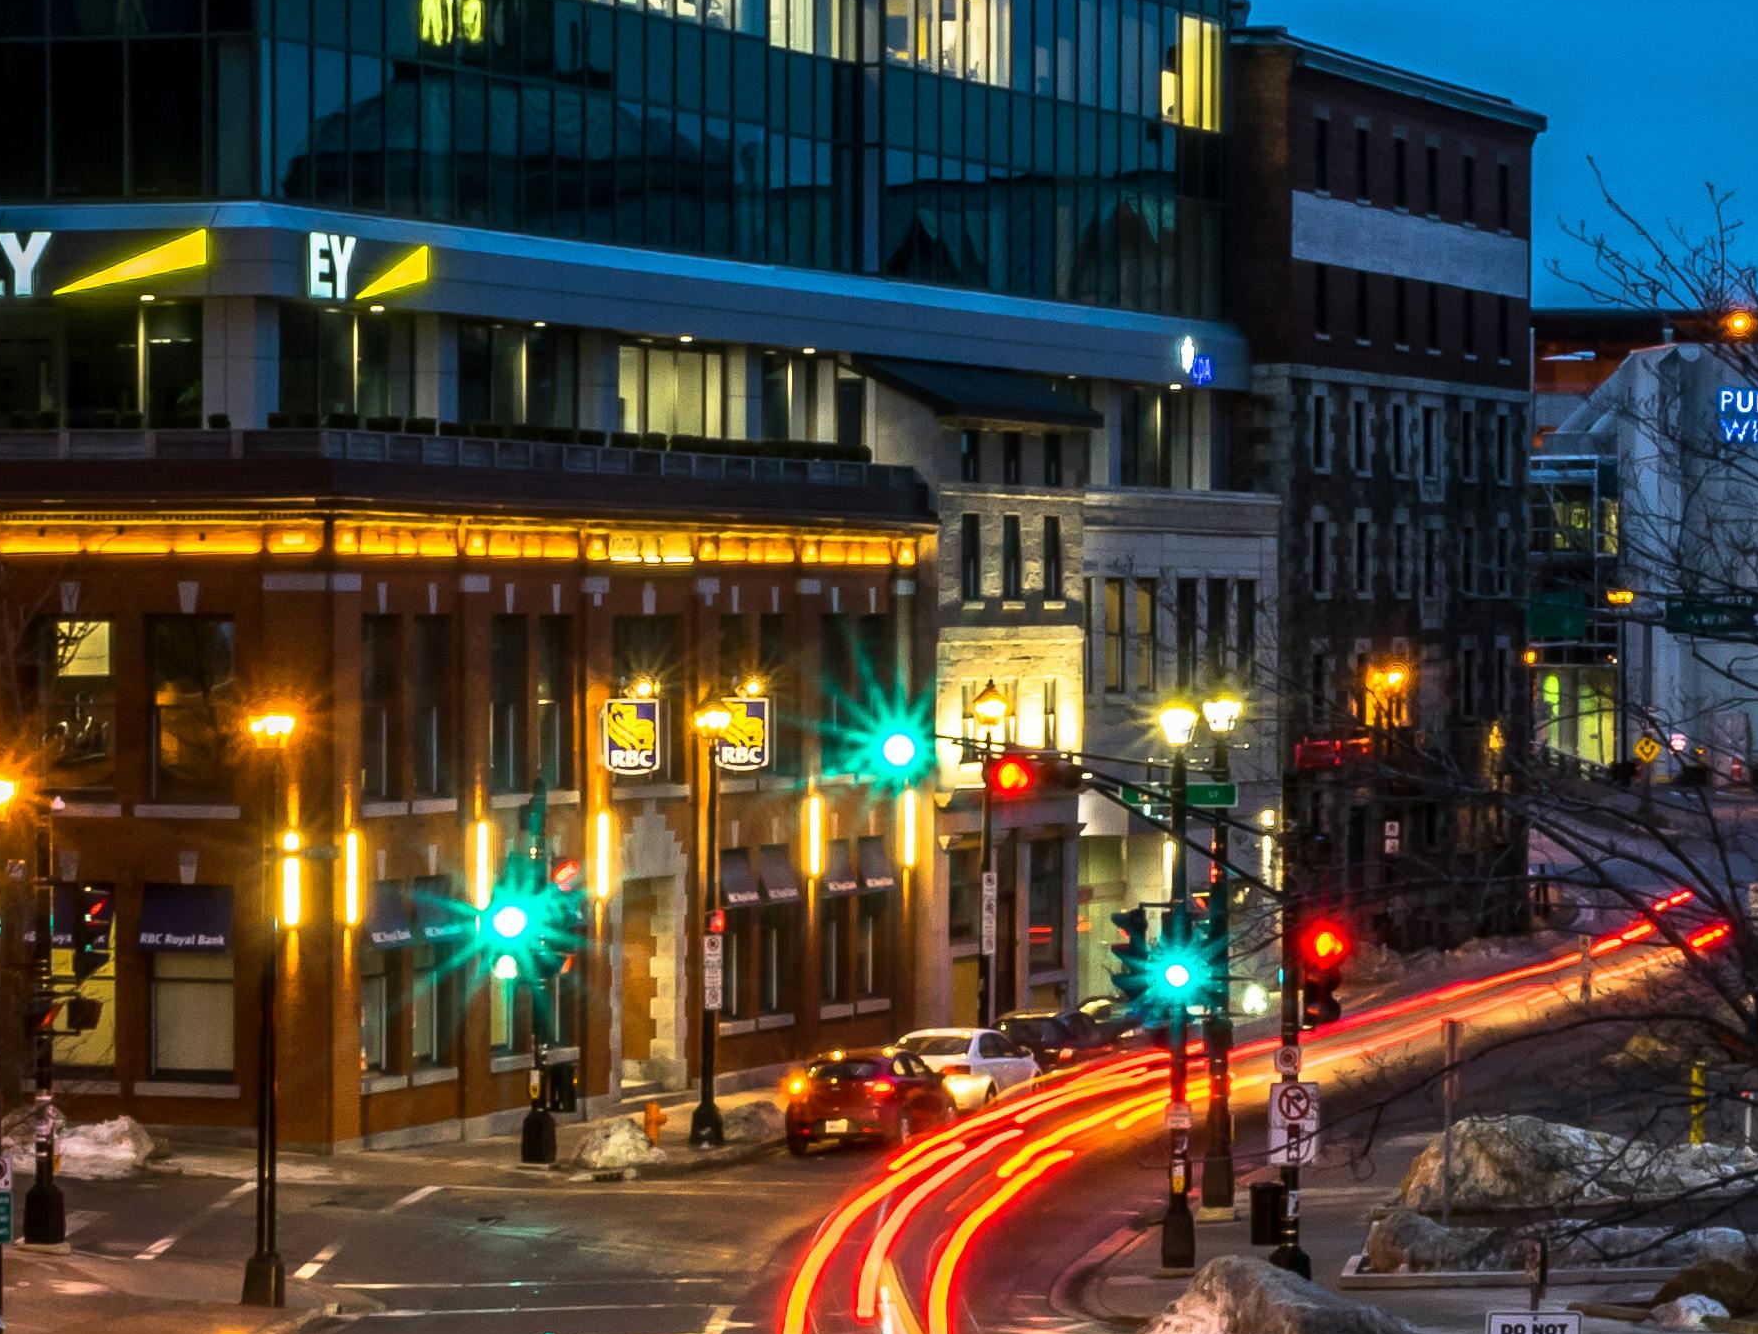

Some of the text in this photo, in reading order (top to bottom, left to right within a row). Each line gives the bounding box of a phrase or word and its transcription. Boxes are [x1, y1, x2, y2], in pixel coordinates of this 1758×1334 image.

[308, 232, 356, 299] EY
[610, 749, 654, 768] RBC
[721, 746, 763, 764] RBC
[140, 932, 225, 947] RBC Royal Bank
